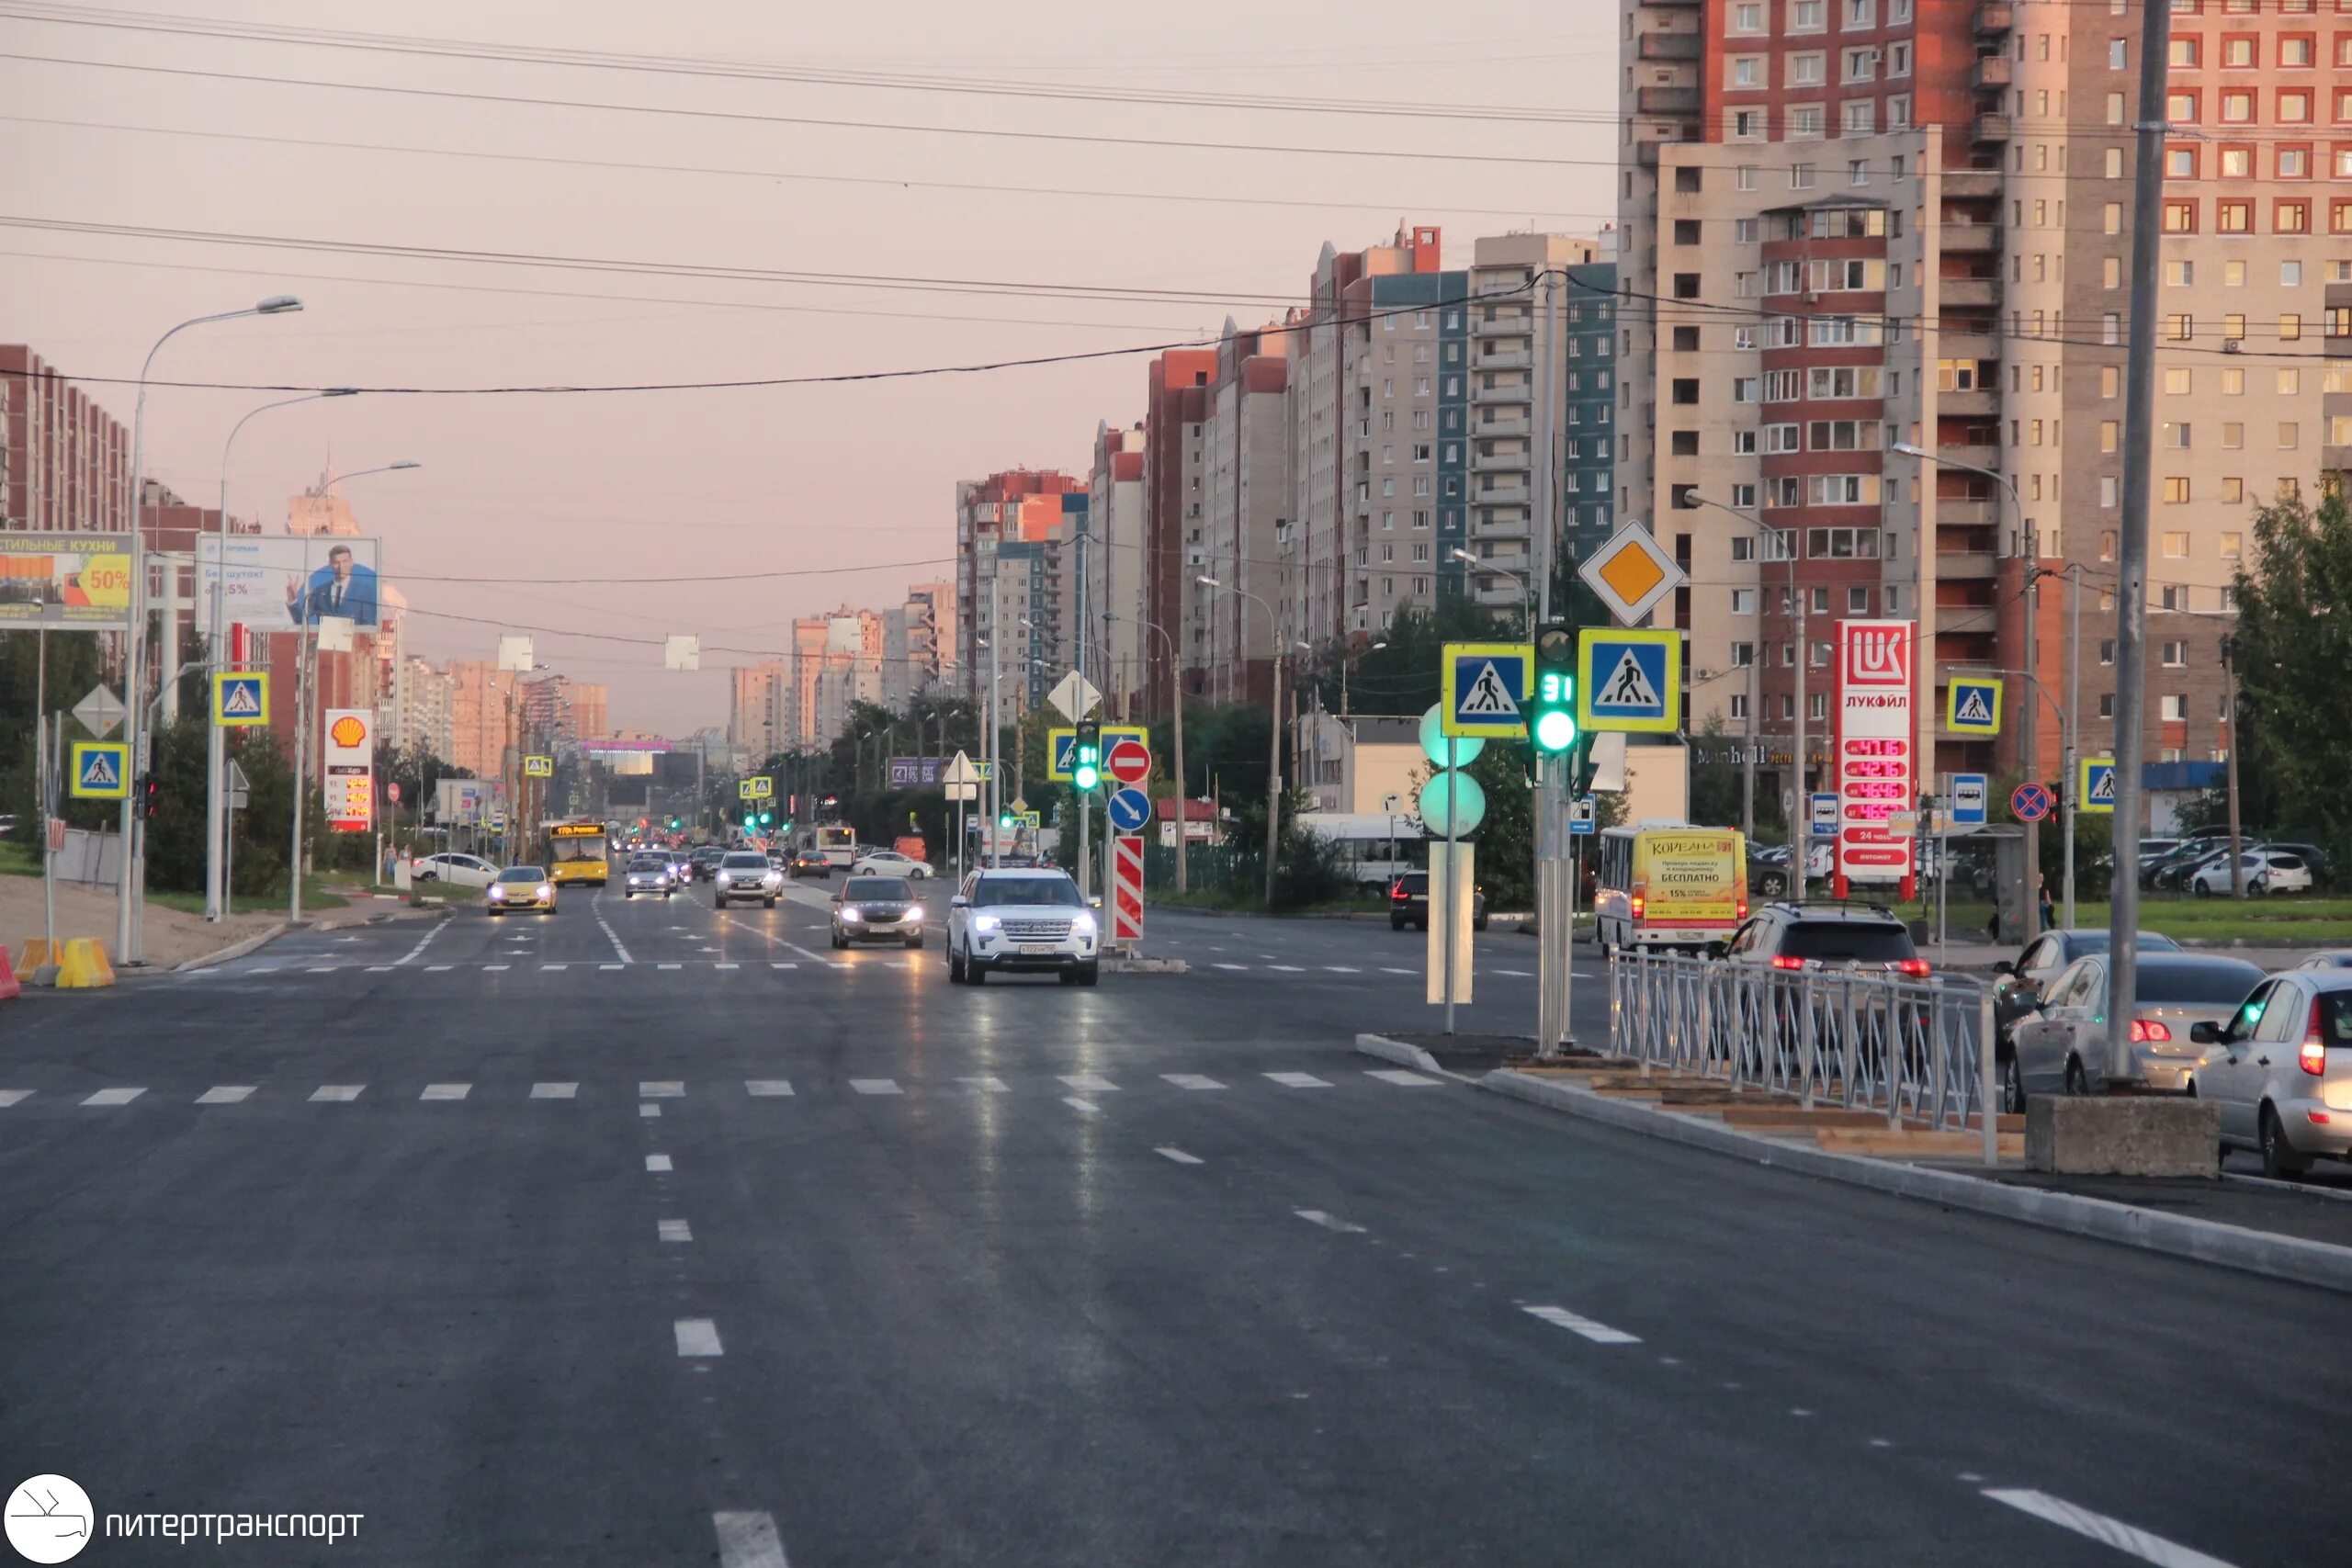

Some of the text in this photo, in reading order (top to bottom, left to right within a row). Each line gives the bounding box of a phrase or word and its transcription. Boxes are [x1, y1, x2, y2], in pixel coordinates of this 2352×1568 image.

[70, 540, 117, 552] КУХНИ
[90, 570, 131, 589] 50%
[1544, 674, 1572, 703] 31
[1846, 694, 1907, 707] ЛУКОЙЛ
[1860, 831, 1871, 840] 24
[1661, 874, 1720, 882] БЕСПЛАТНО
[1669, 889, 1687, 897] 15%
